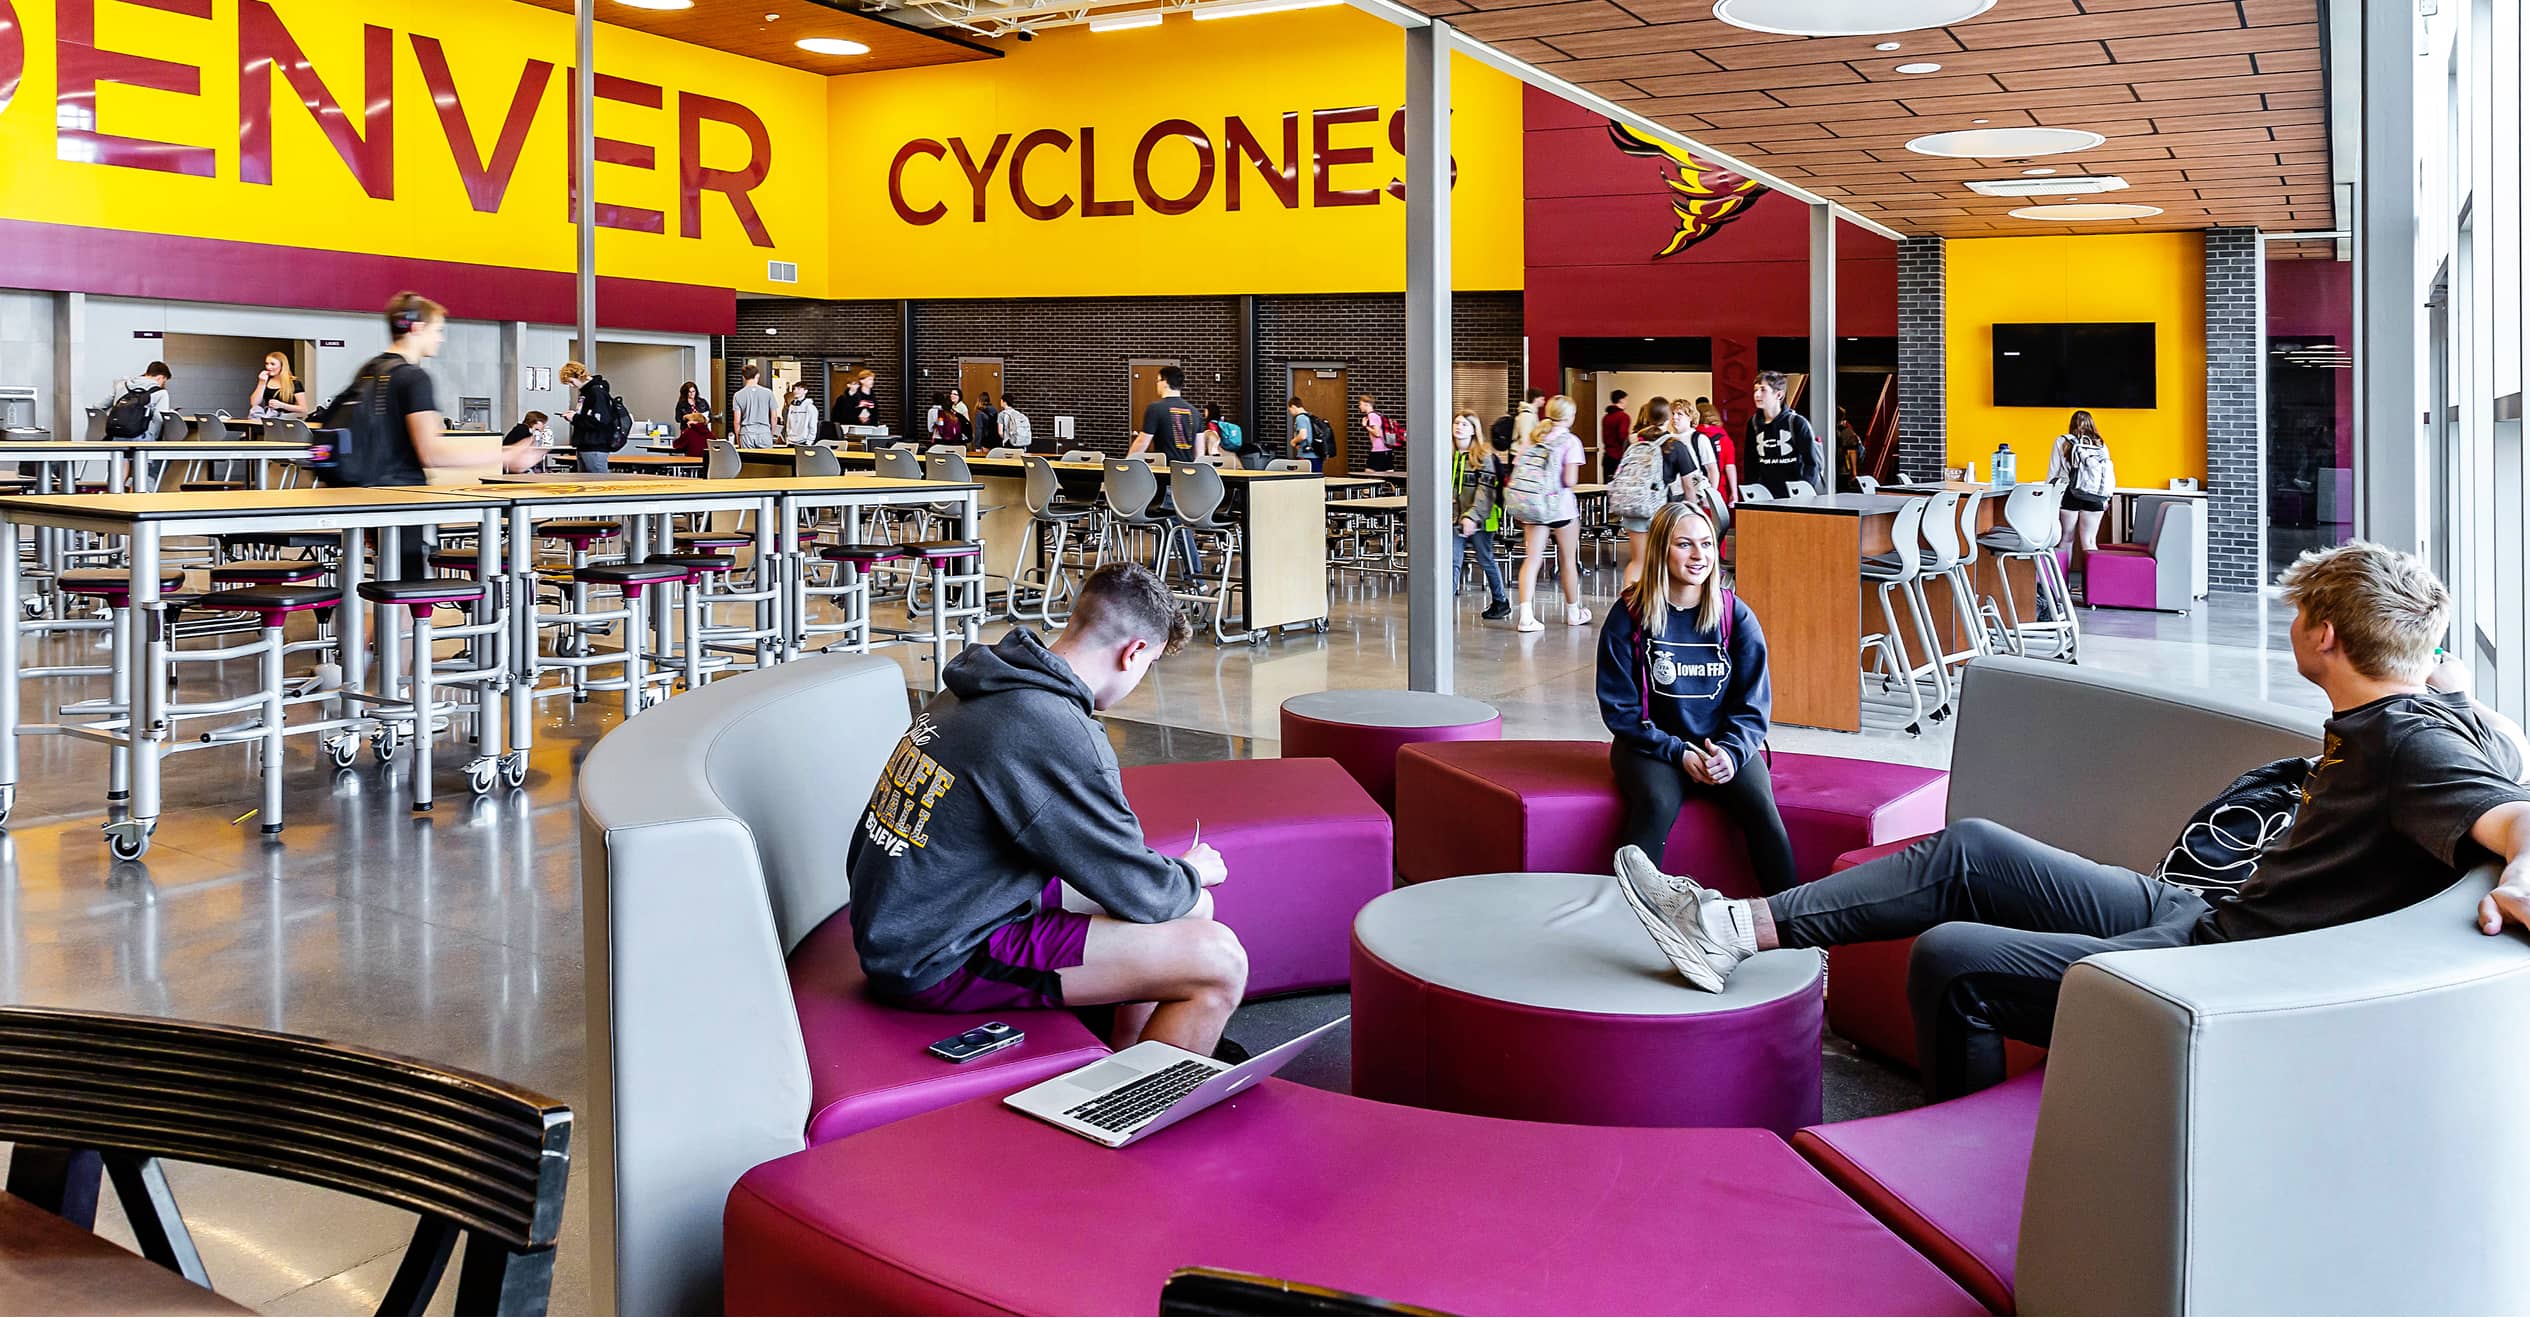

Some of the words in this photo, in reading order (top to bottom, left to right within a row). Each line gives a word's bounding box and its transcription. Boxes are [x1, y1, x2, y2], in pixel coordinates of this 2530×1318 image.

[0, 0, 775, 249] ENVER
[1676, 662, 1705, 676] Iowa
[1706, 662, 1725, 676] FFA
